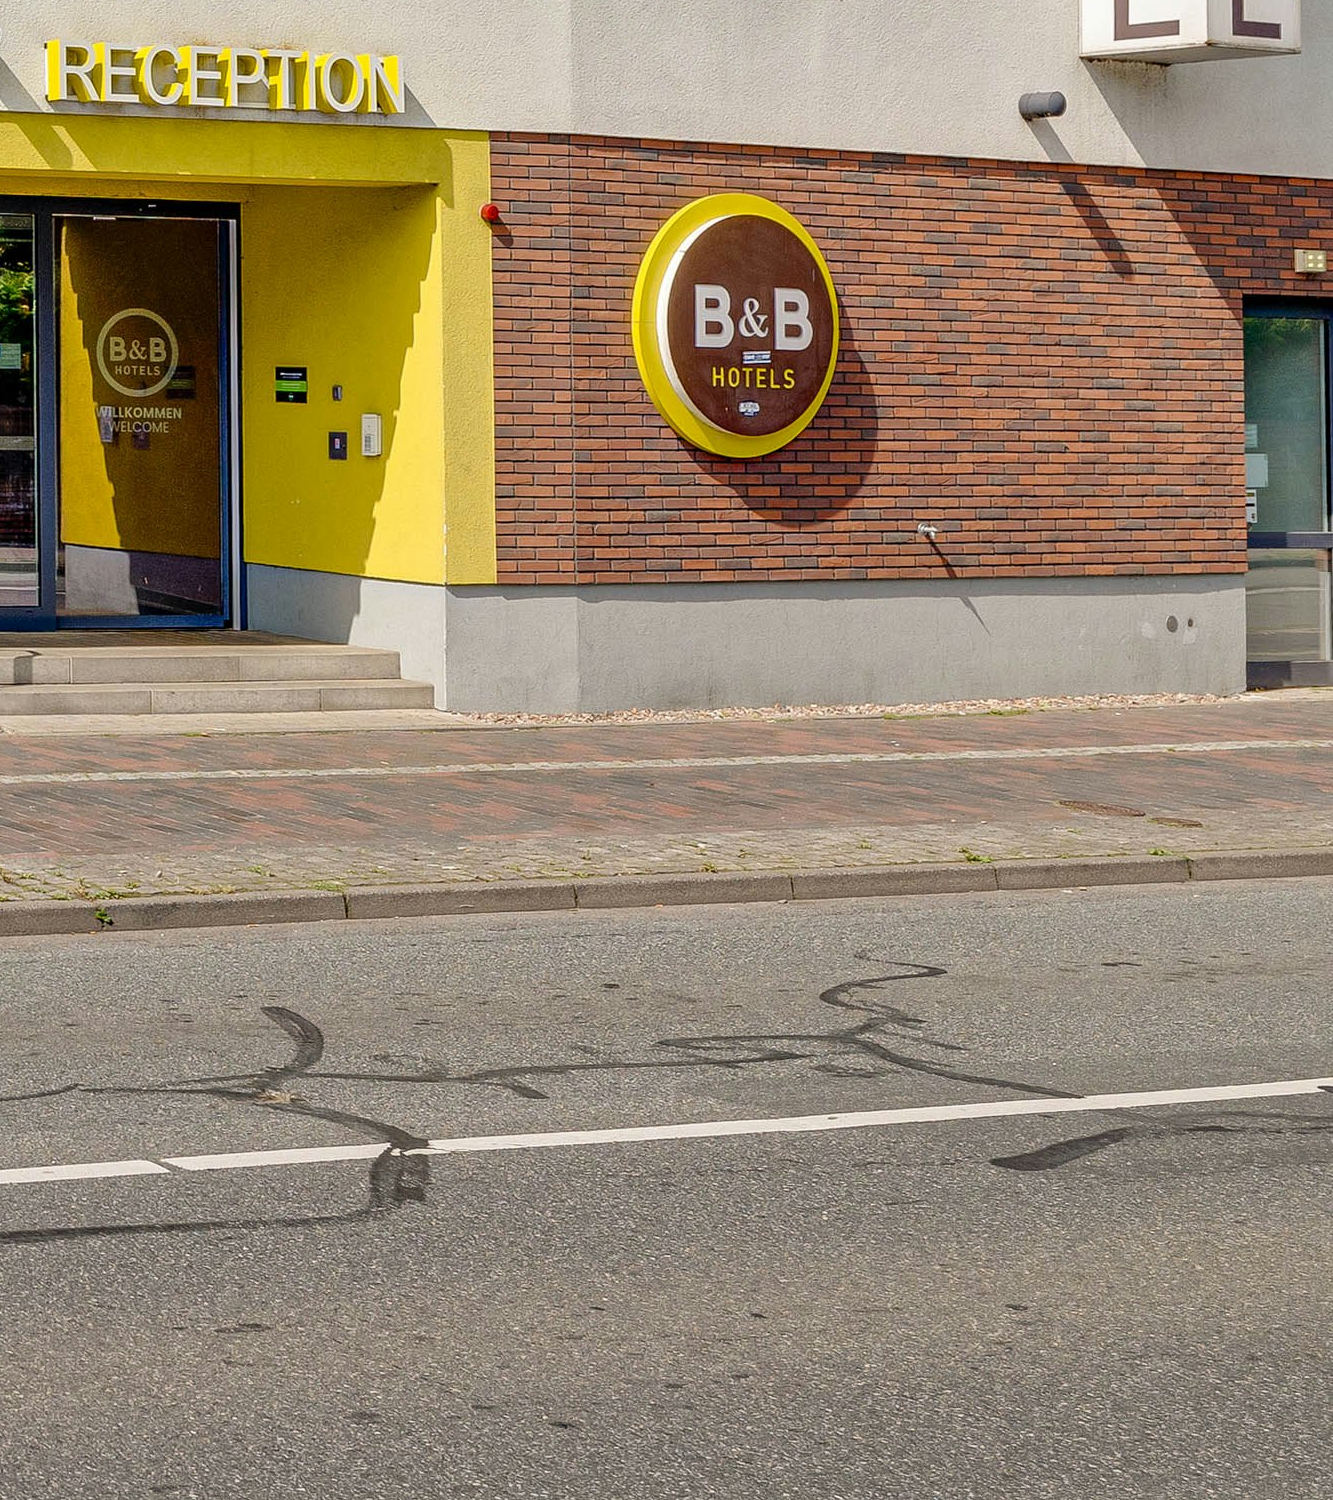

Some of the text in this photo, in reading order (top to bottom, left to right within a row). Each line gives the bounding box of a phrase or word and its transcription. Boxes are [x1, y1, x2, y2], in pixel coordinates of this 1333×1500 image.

[44, 39, 407, 115] RECEPTION
[694, 284, 814, 351] B&B
[109, 336, 167, 362] B&B
[114, 365, 161, 376] HOTELS
[711, 366, 796, 390] HOTELS
[96, 406, 182, 419] WILLKOMMEN
[109, 421, 170, 433] WELCOME
